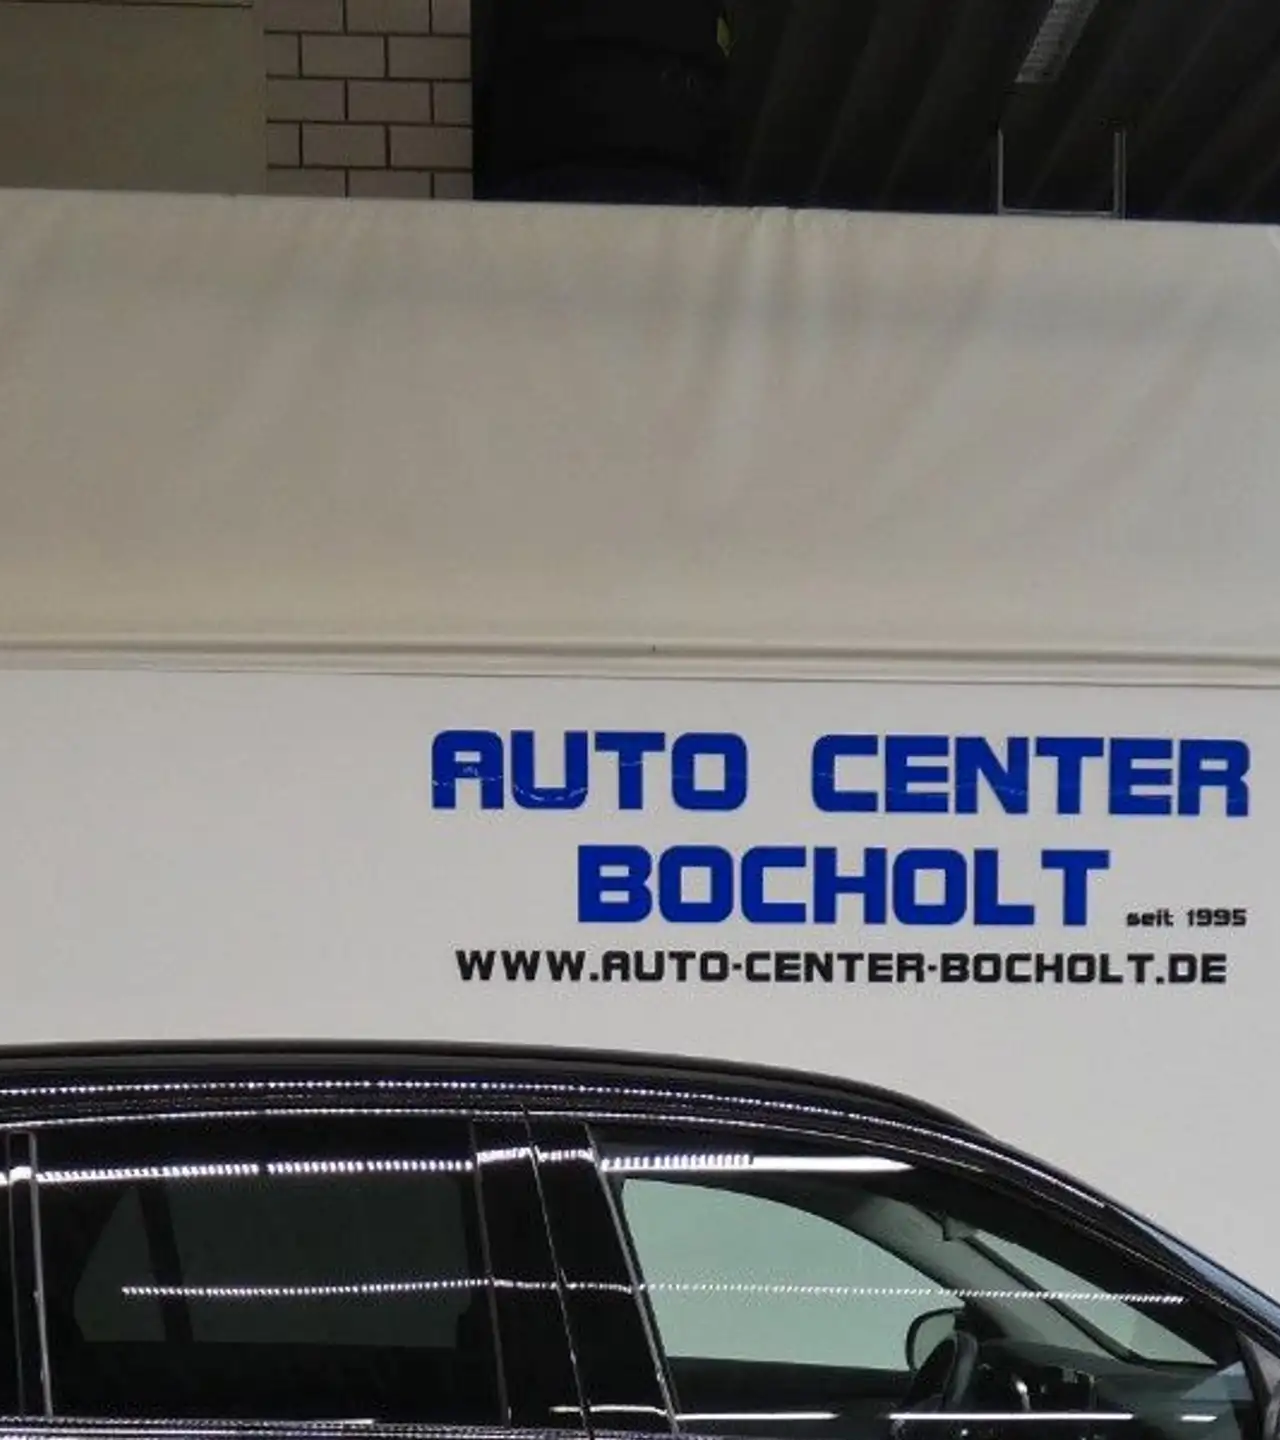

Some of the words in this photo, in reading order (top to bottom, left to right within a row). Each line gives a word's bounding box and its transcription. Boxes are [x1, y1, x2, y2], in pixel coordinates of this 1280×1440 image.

[431, 729, 750, 814] AUTO
[810, 733, 1252, 820] CENTER
[577, 843, 1113, 928] BOCHOLT
[1127, 908, 1174, 927] seit
[1186, 908, 1247, 927] 1995
[455, 949, 1228, 985] WWW.AUTO-CENTER-BOCHOLT.DE
